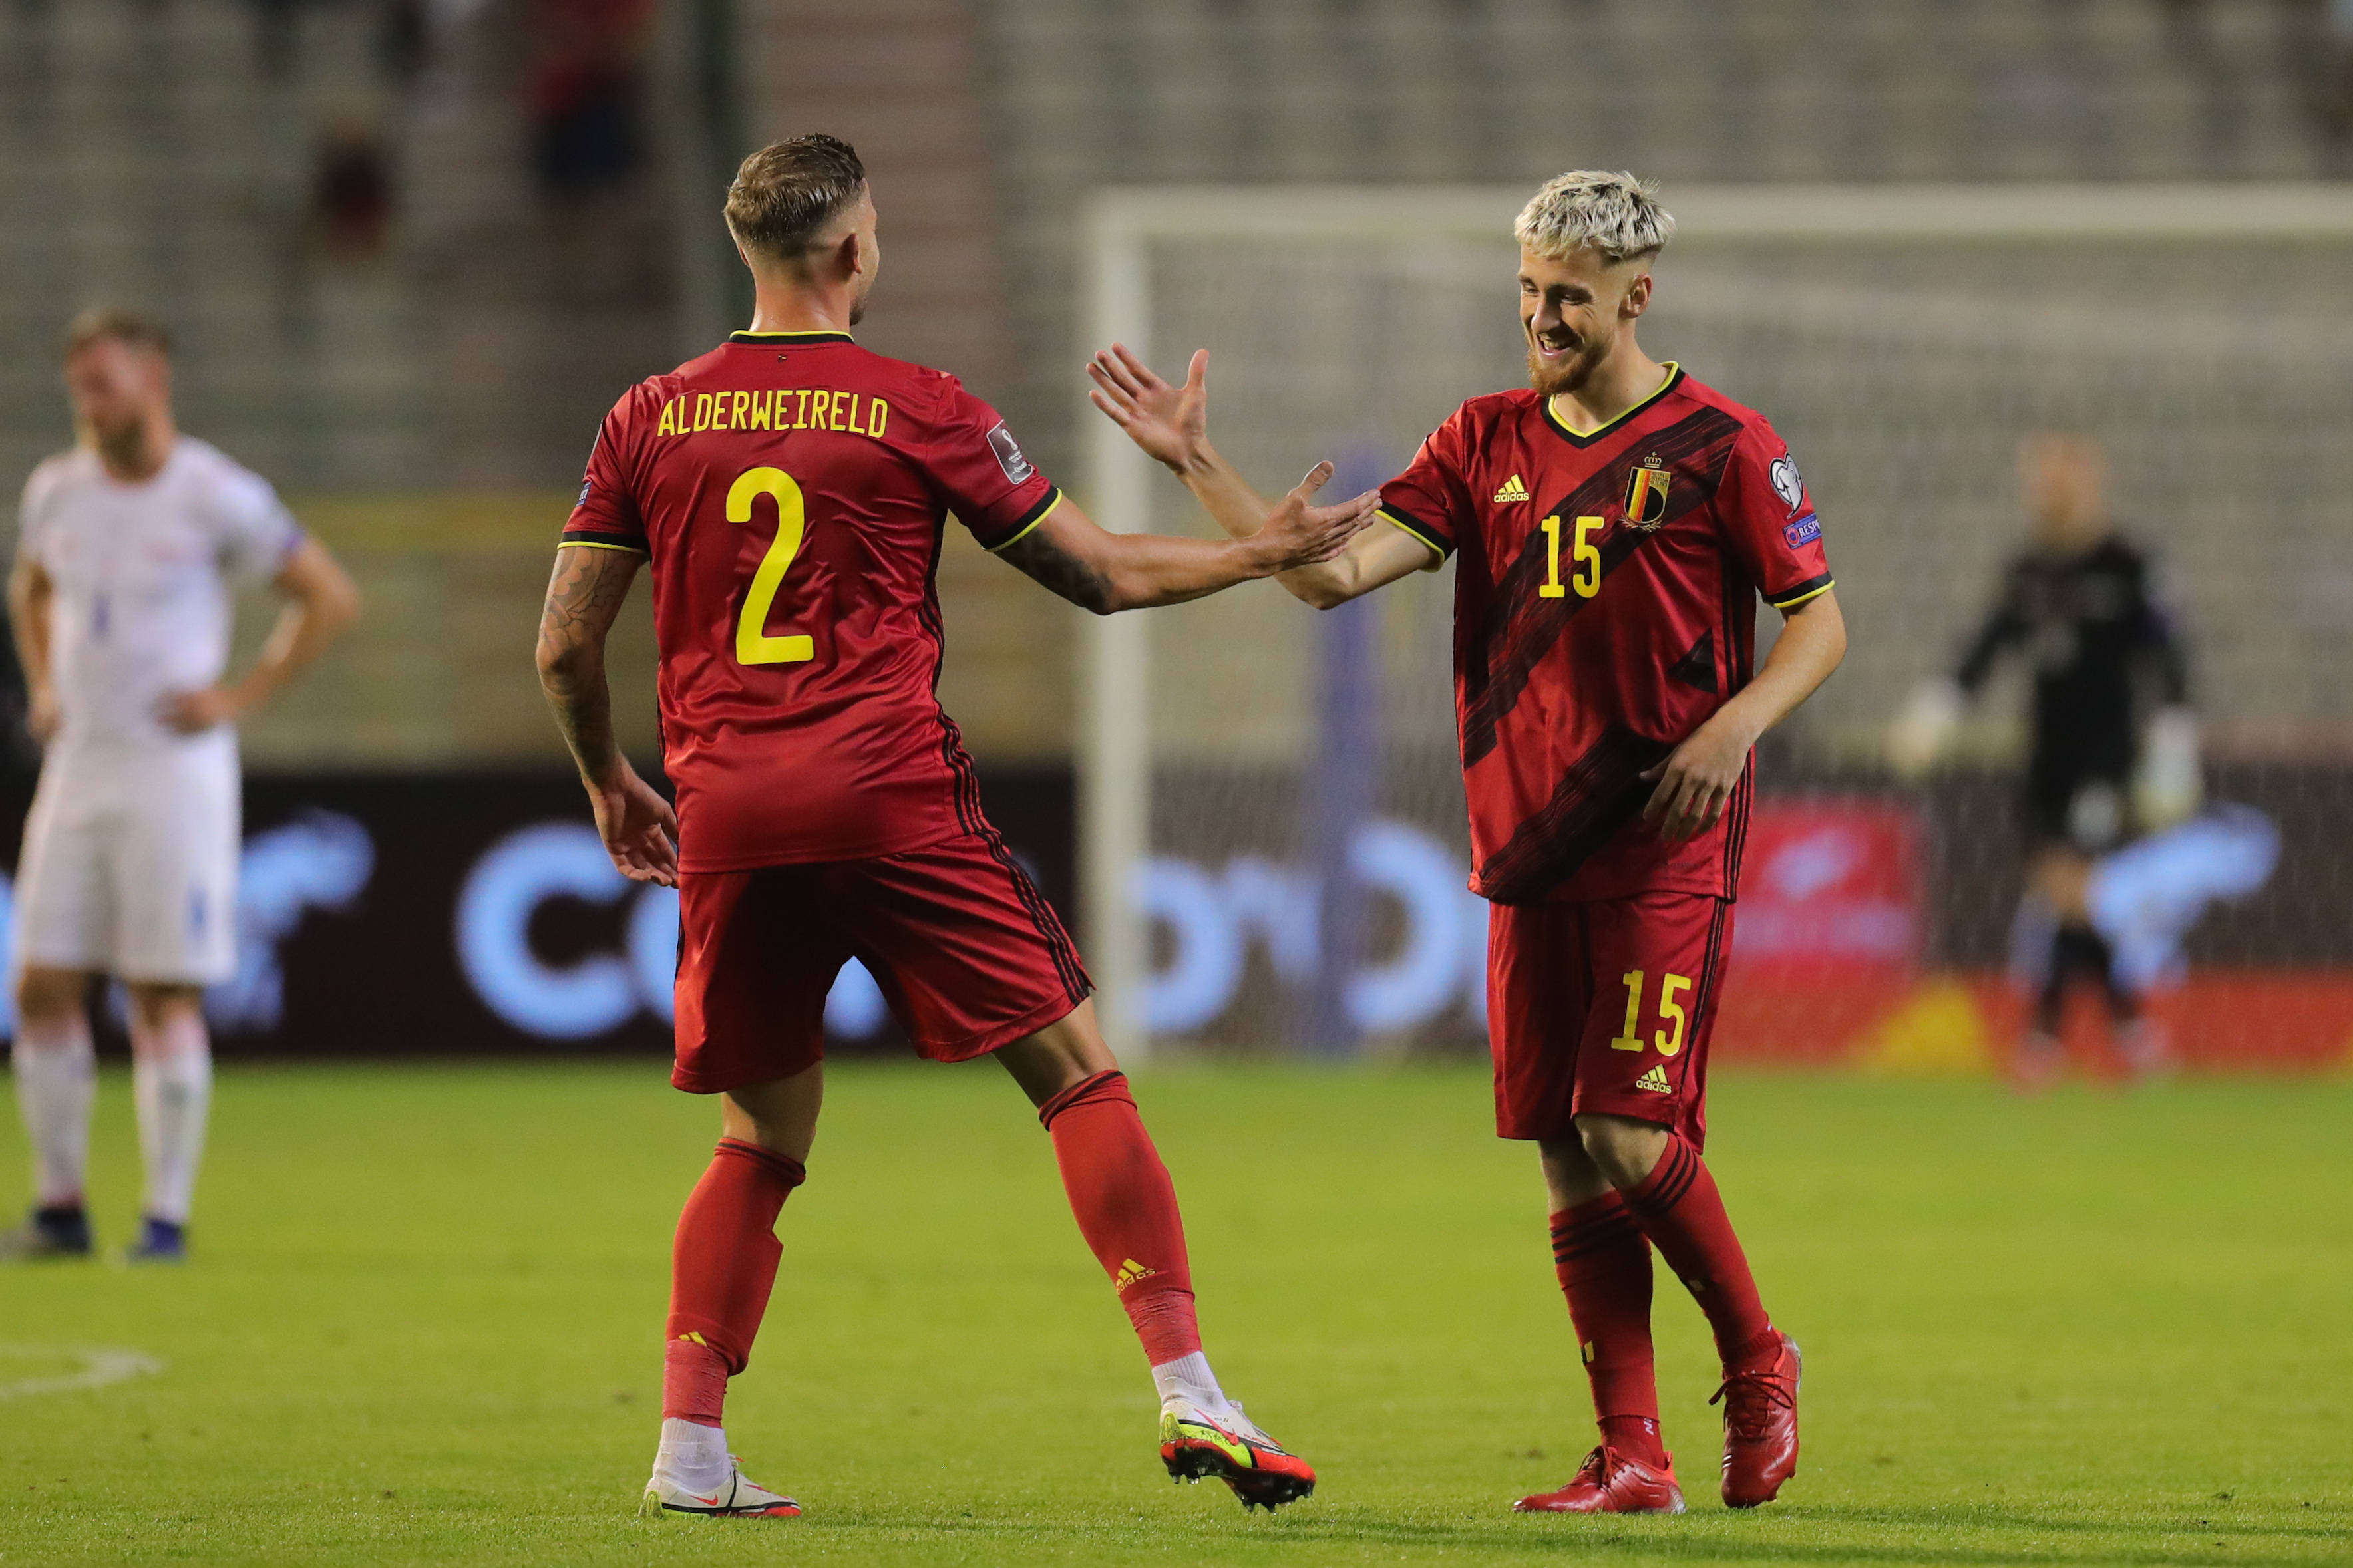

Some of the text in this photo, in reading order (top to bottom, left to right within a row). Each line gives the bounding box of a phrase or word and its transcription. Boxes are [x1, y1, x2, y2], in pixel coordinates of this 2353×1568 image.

[657, 389, 888, 438] ALDERWEIRELD
[1493, 492, 1529, 503] adidas
[725, 466, 814, 665] 2
[1538, 514, 1604, 599] 15
[1611, 969, 1692, 1056] 15
[1636, 1079, 1672, 1094] adidas
